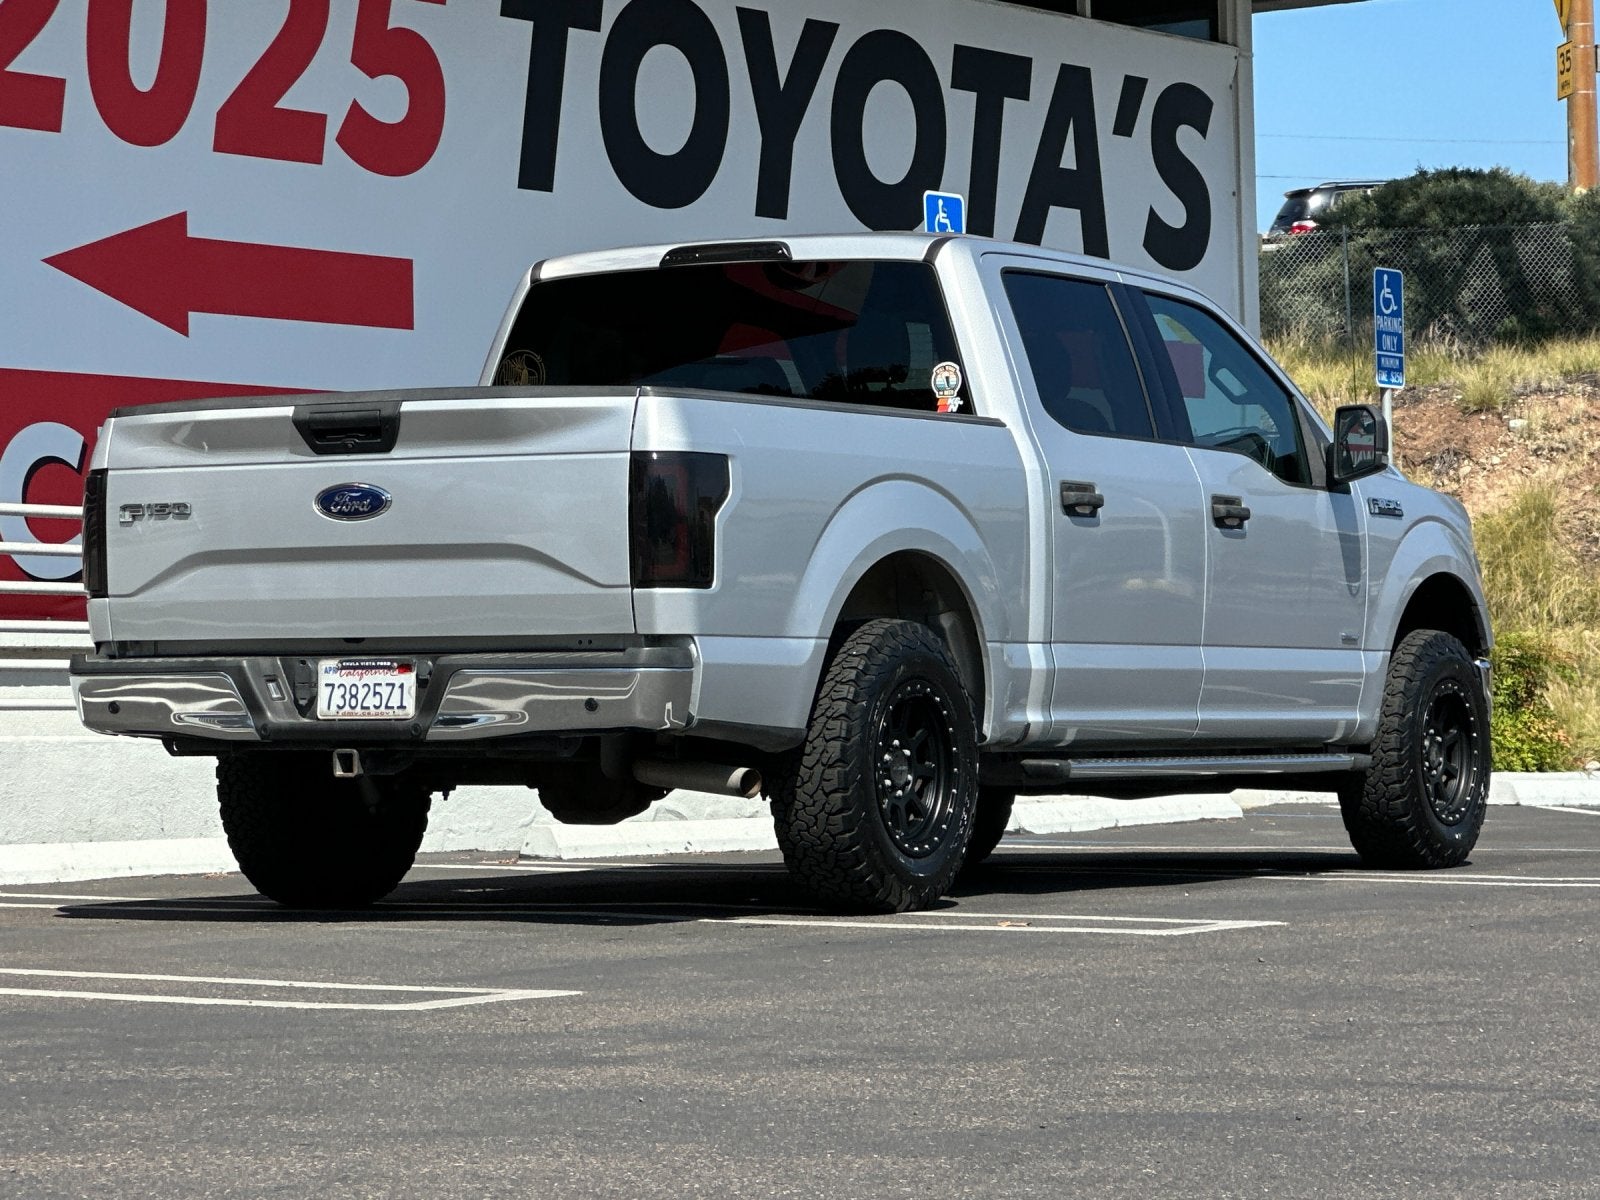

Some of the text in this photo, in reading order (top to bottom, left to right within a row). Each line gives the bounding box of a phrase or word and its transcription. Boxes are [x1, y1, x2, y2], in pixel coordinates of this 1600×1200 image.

[1560, 49, 1572, 75] 35
[501, 0, 1214, 271] TOYOTA'S
[1377, 315, 1402, 333] PARKING
[1382, 334, 1398, 351] ONLY
[329, 491, 372, 513] Ford
[324, 682, 407, 711] 73825Z1
